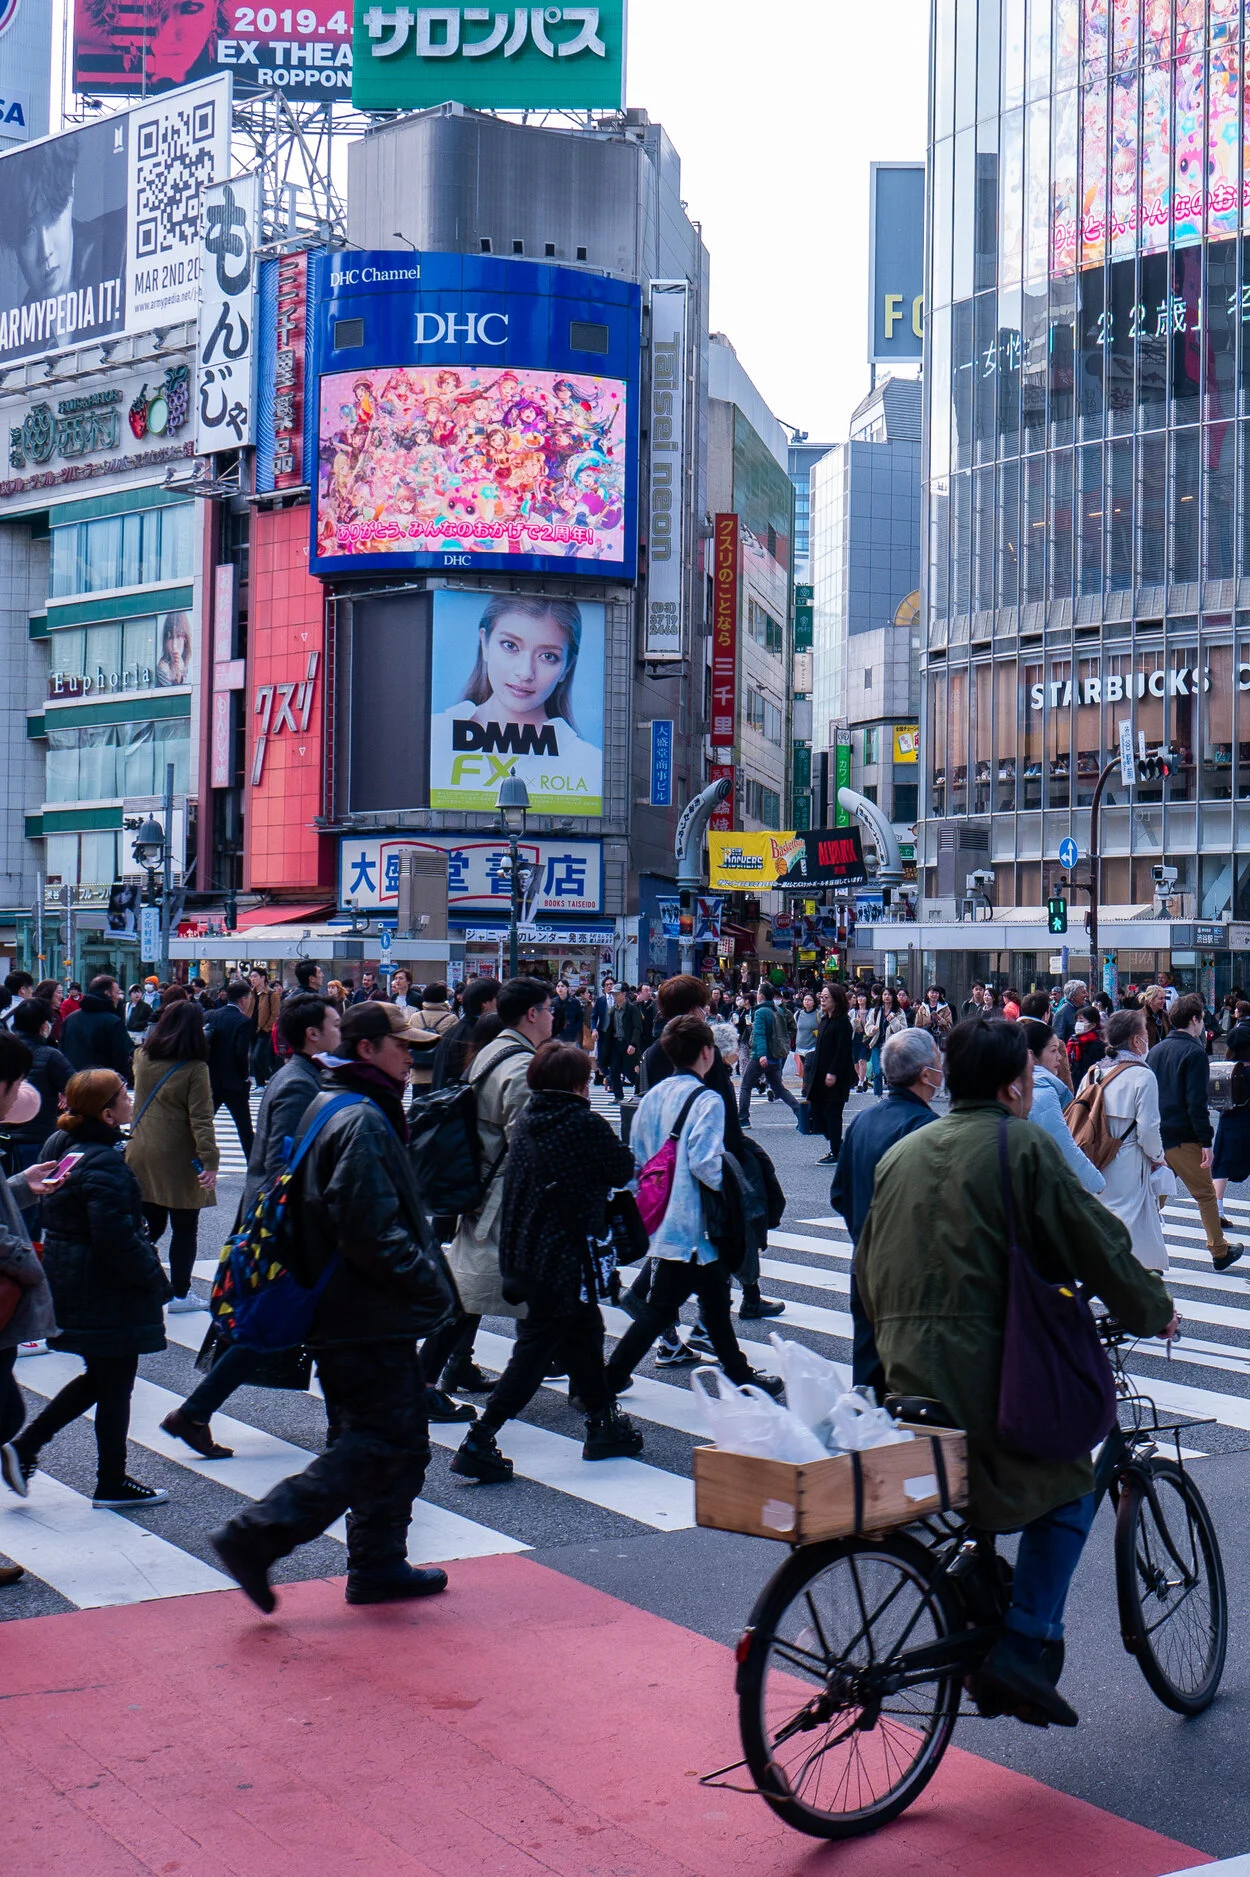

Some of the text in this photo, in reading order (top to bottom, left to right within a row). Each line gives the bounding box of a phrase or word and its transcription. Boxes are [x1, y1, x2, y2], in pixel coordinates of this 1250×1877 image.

[363, 6, 606, 58] サロンパス
[217, 40, 353, 67] EX THEA
[134, 268, 159, 297] MAR
[162, 261, 185, 289] 2ND
[330, 264, 421, 287] DHC Channel
[0, 278, 121, 350] ARMYPEDIA IT!
[201, 185, 252, 441] もんじゃ
[413, 312, 510, 346] DHC
[273, 260, 302, 474] 三千里薬品
[651, 331, 680, 562] Taisei neon
[337, 521, 595, 545] ありがとう、みんなのおかげで2周年!
[443, 555, 472, 566] DHC
[713, 520, 735, 736] クスリのことなら 三千里
[53, 663, 151, 697] Euphoria
[1030, 666, 1212, 710] STARBUCKS
[452, 719, 560, 757] DMM
[450, 754, 520, 787] FX
[540, 775, 589, 792] ROLA
[544, 899, 596, 908] BOOKS TAISEIDO
